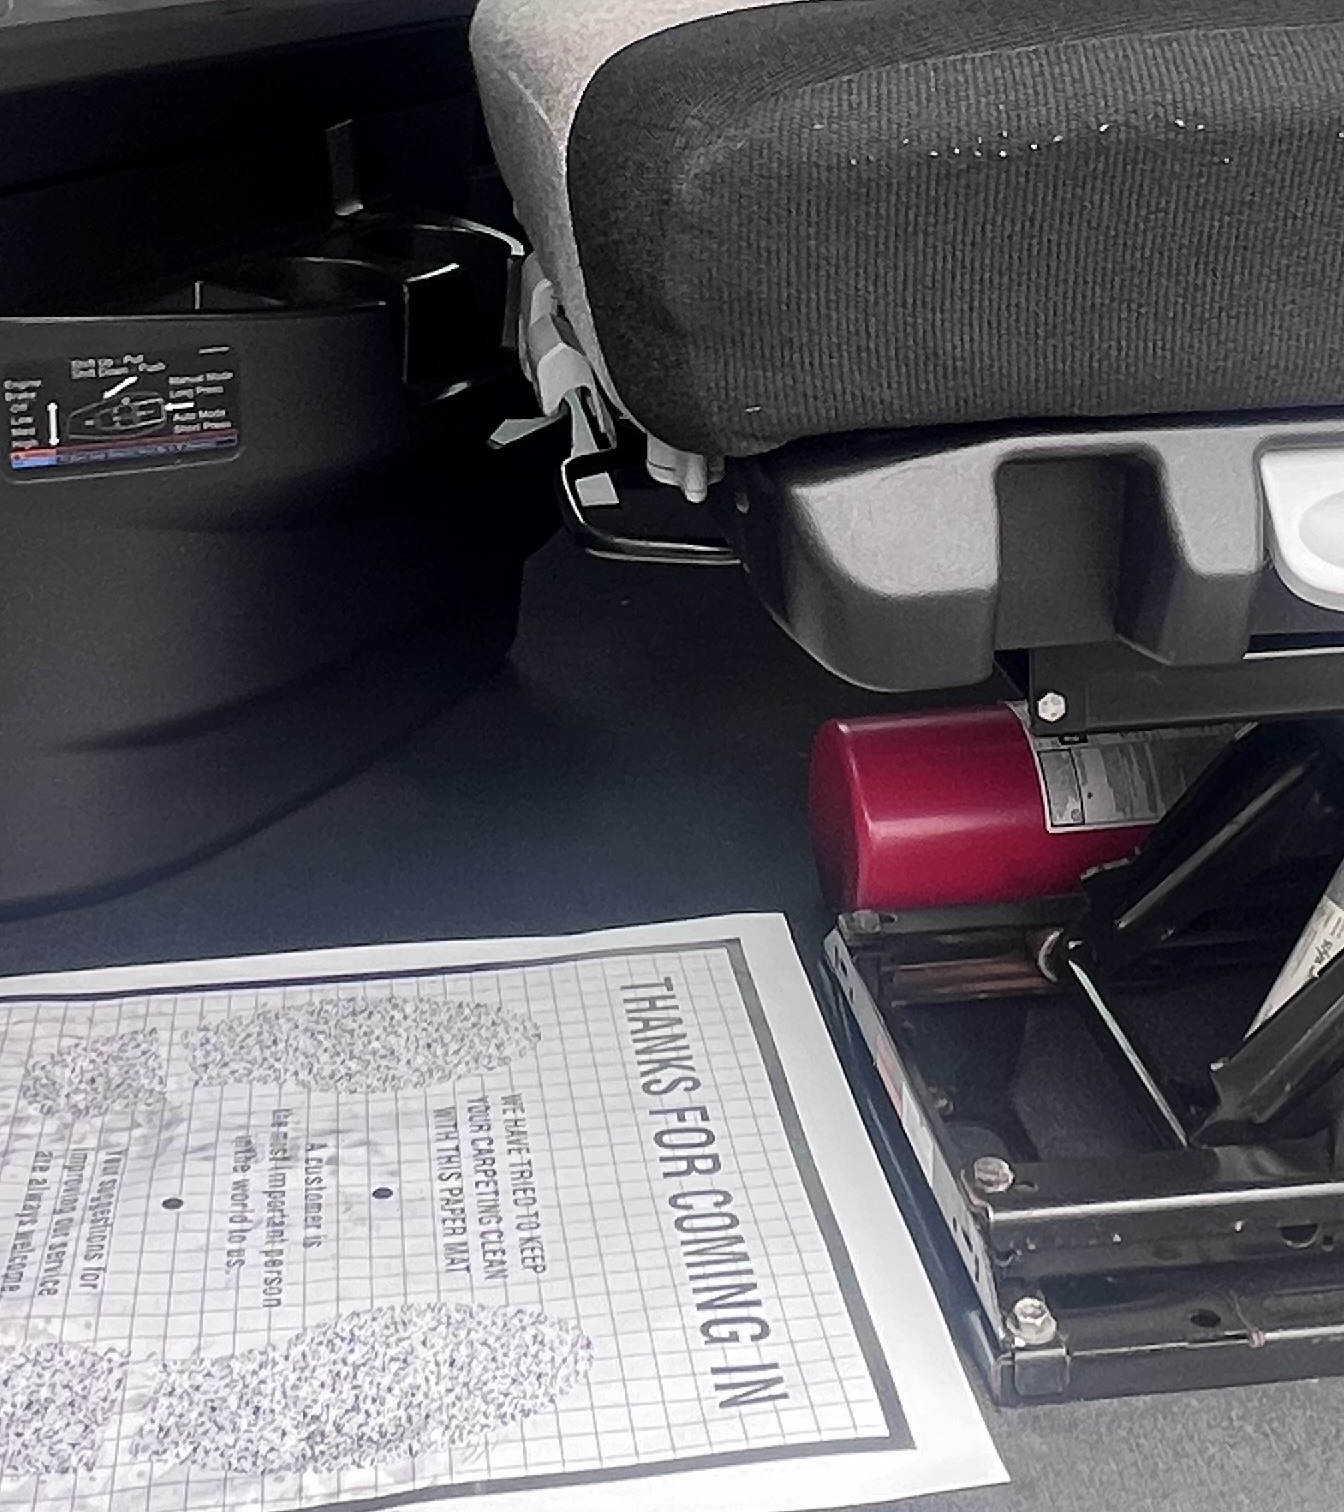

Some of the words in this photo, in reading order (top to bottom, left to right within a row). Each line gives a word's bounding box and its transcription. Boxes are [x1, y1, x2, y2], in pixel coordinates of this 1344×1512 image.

[620, 976, 701, 1096] THANKS
[433, 1106, 459, 1142] WITH
[467, 1094, 491, 1134] YOUR
[501, 1092, 525, 1115] WE
[306, 1142, 328, 1152] A
[503, 1118, 531, 1155] HAVE
[649, 1105, 722, 1178] FOR
[436, 1144, 462, 1182] THIS
[471, 1137, 503, 1225] CARPETING
[509, 1159, 537, 1206] TRIED
[229, 1178, 256, 1224] world
[304, 1156, 328, 1230] customer
[439, 1187, 467, 1237] PAPER
[227, 1226, 253, 1244] to
[303, 1234, 328, 1248] is
[515, 1210, 540, 1231] TO
[38, 1241, 69, 1296] service
[443, 1241, 471, 1273] MAT
[479, 1230, 508, 1281] CLEAN
[519, 1236, 547, 1274] KEEP
[668, 1189, 771, 1345] COMING
[80, 1265, 107, 1289] for
[259, 1248, 284, 1308] person
[710, 1362, 789, 1408] IN
